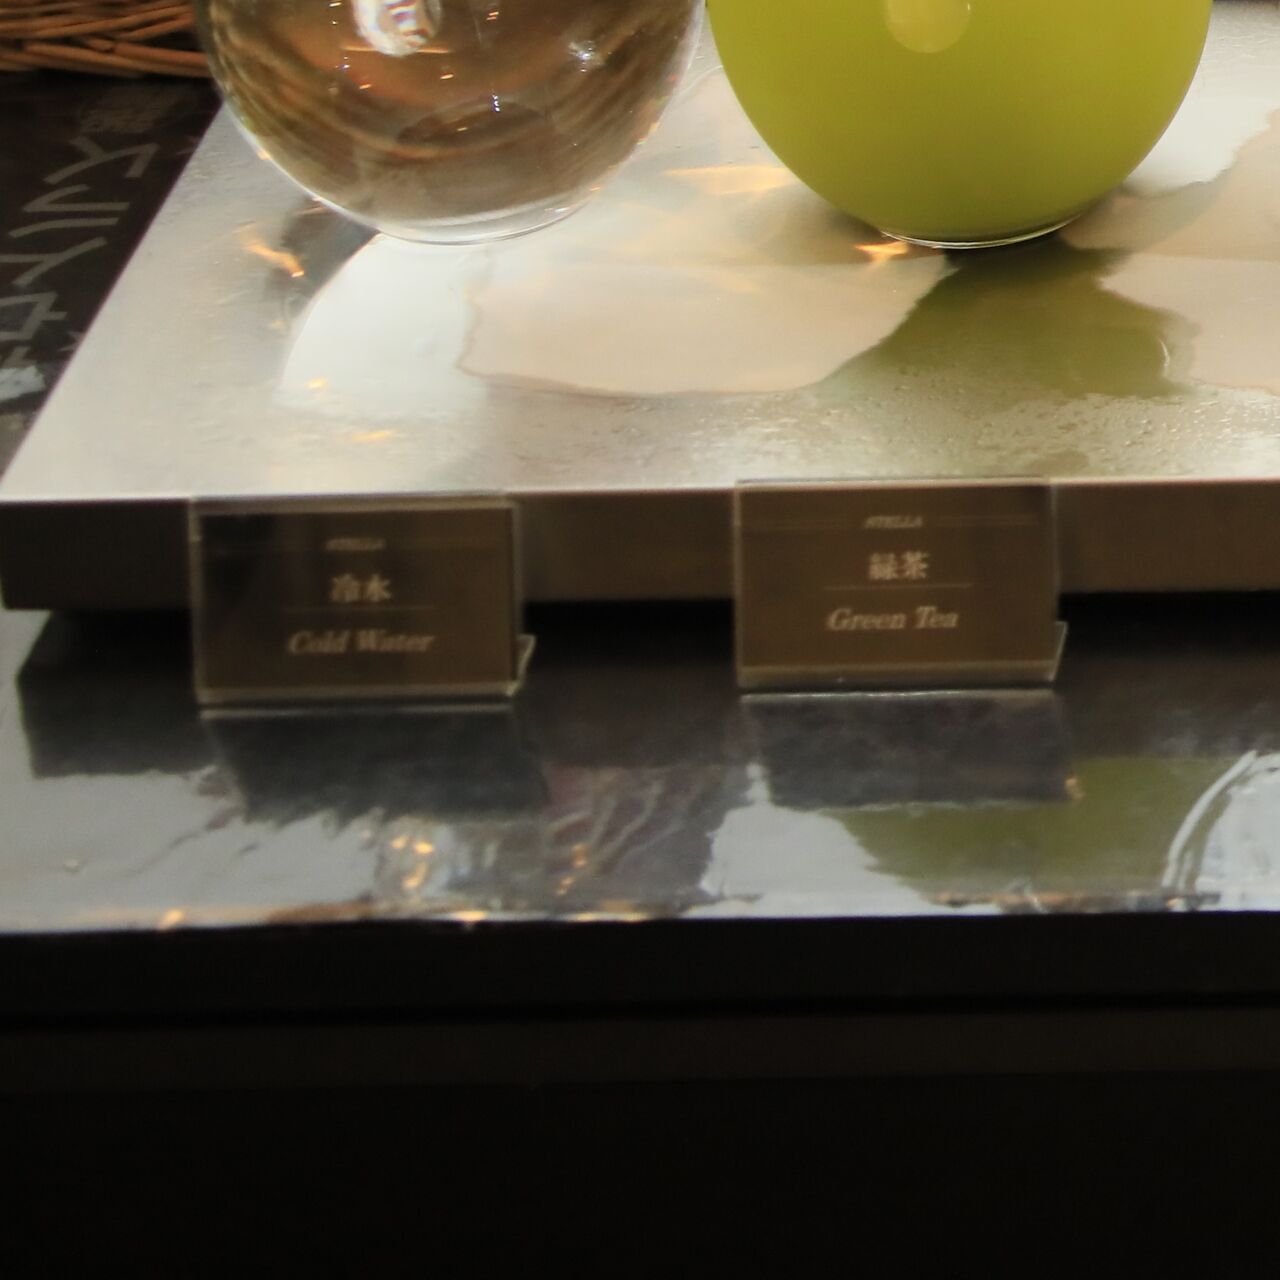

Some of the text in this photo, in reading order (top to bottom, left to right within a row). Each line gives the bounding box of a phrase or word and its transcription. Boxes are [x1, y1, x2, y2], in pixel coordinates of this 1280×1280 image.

[868, 551, 930, 581] 緑茶
[826, 606, 960, 632] Green Tea
[287, 629, 436, 655] Cold Water
